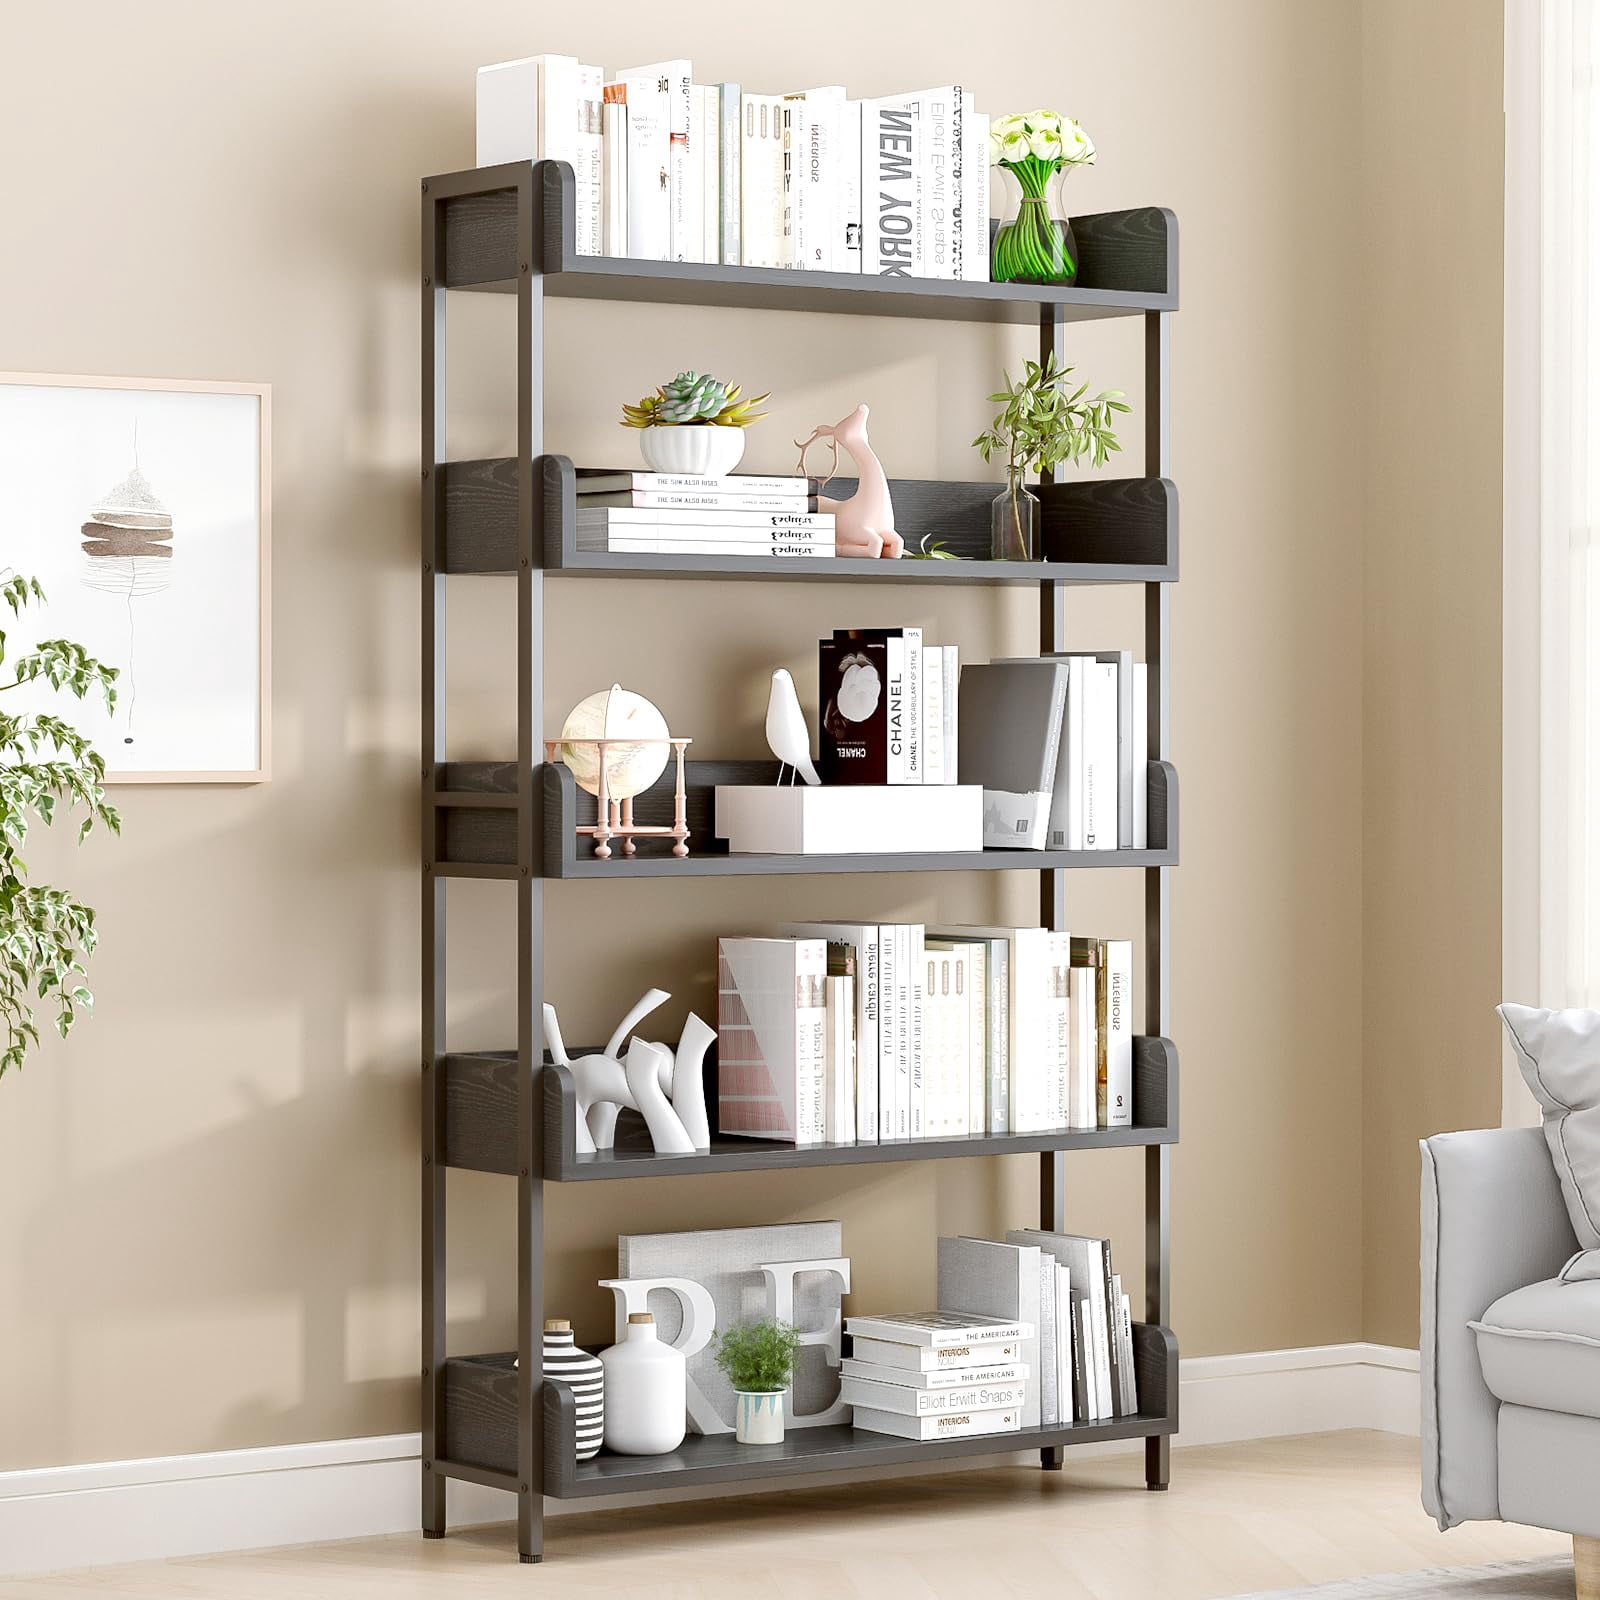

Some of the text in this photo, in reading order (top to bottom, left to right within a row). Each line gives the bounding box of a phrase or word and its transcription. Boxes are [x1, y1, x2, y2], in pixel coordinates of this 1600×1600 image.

[910, 671, 917, 680] OF
[890, 673, 902, 756] CHANEL
[836, 747, 866, 758] CHANEL
[981, 1329, 1020, 1339] AMERICANS
[937, 1347, 970, 1358] INTERIORS
[976, 1371, 1015, 1380] AMERICANS
[920, 1389, 1012, 1410] Elliott Erwitt Snaps
[937, 1416, 970, 1427] INTERIORS
